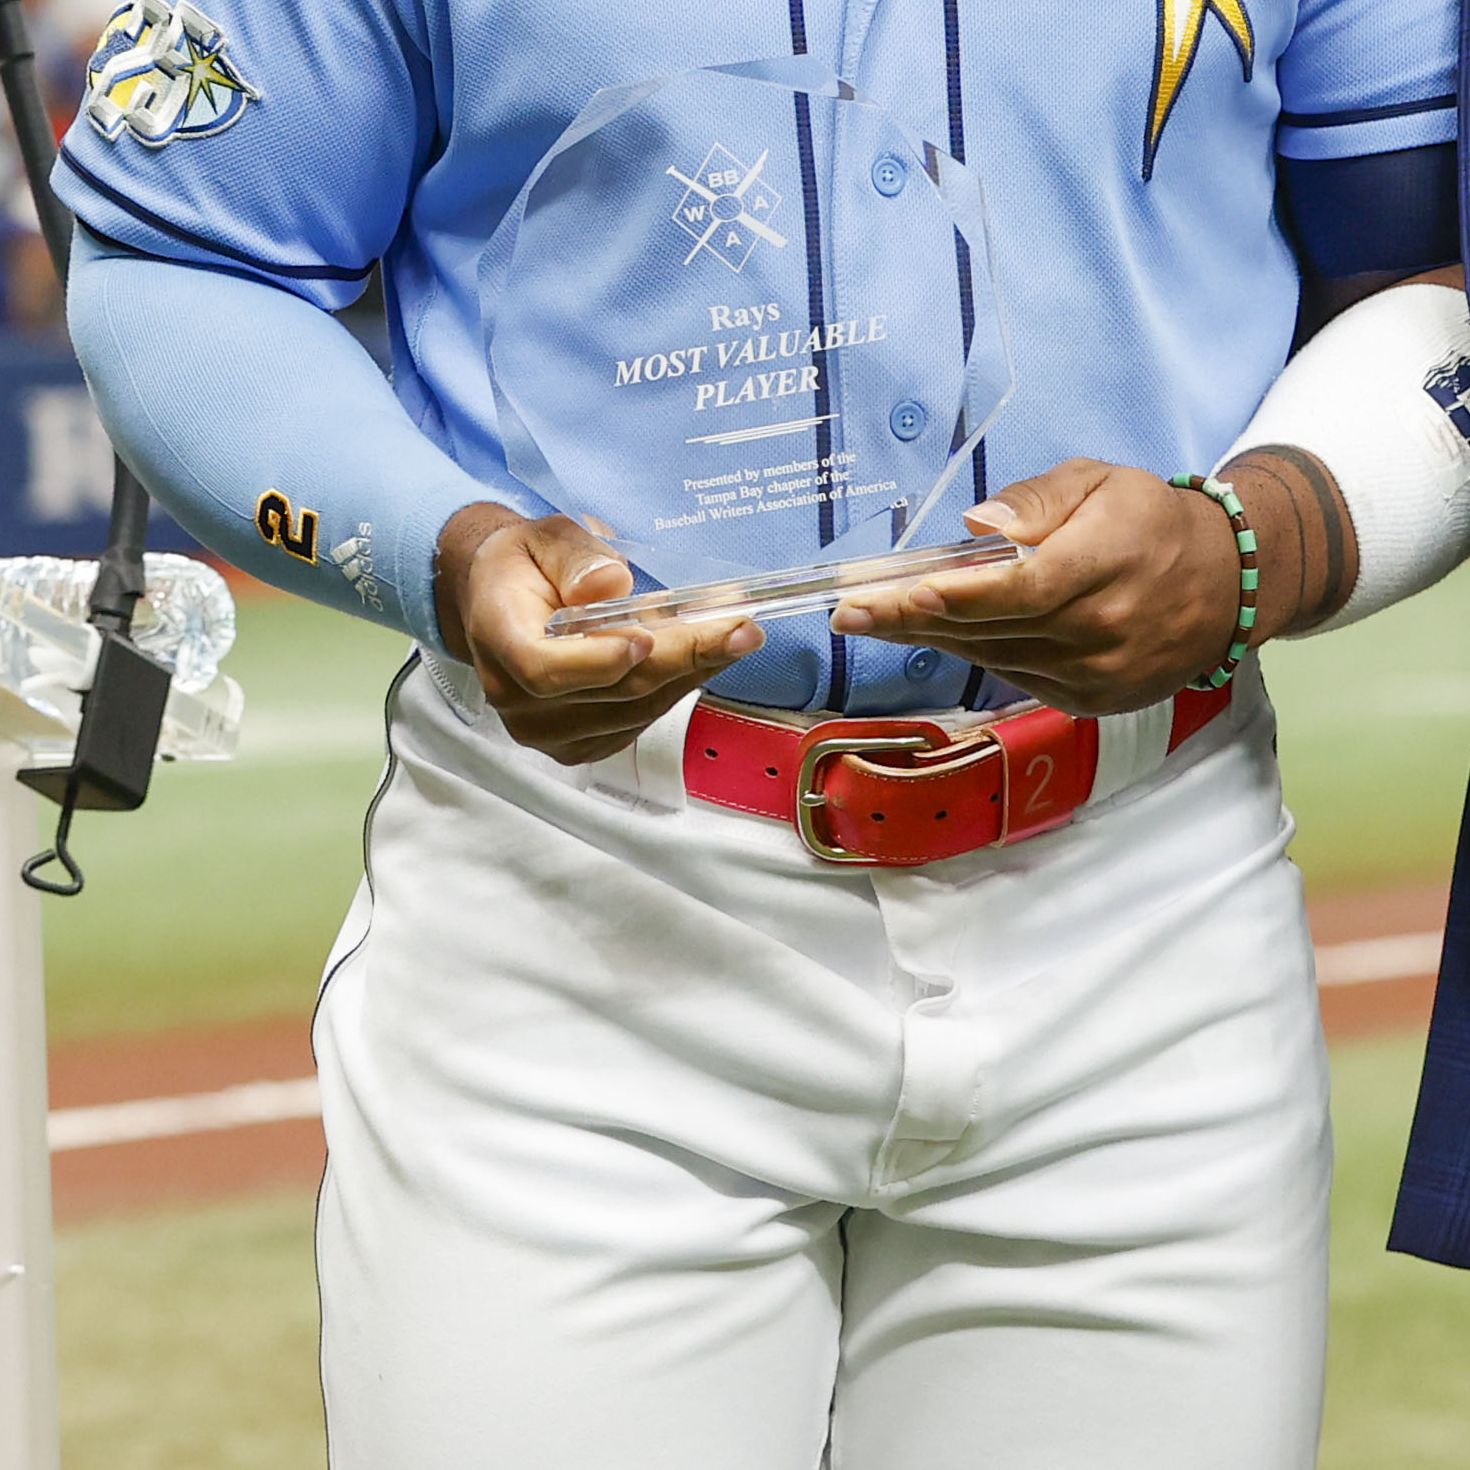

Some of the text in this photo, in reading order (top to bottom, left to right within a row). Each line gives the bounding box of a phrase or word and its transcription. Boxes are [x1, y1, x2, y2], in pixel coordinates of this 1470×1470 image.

[707, 169, 740, 188] BB
[708, 302, 781, 331] Rays
[613, 316, 887, 387] MOST VALUABLE
[695, 365, 821, 410] PLAYER
[683, 452, 857, 492] Presented by members of the
[695, 469, 851, 507] Tampa Bay chapter of the
[254, 488, 319, 566] 2
[654, 479, 897, 531] Baseball Writers Association of America
[1024, 753, 1056, 816] 2
